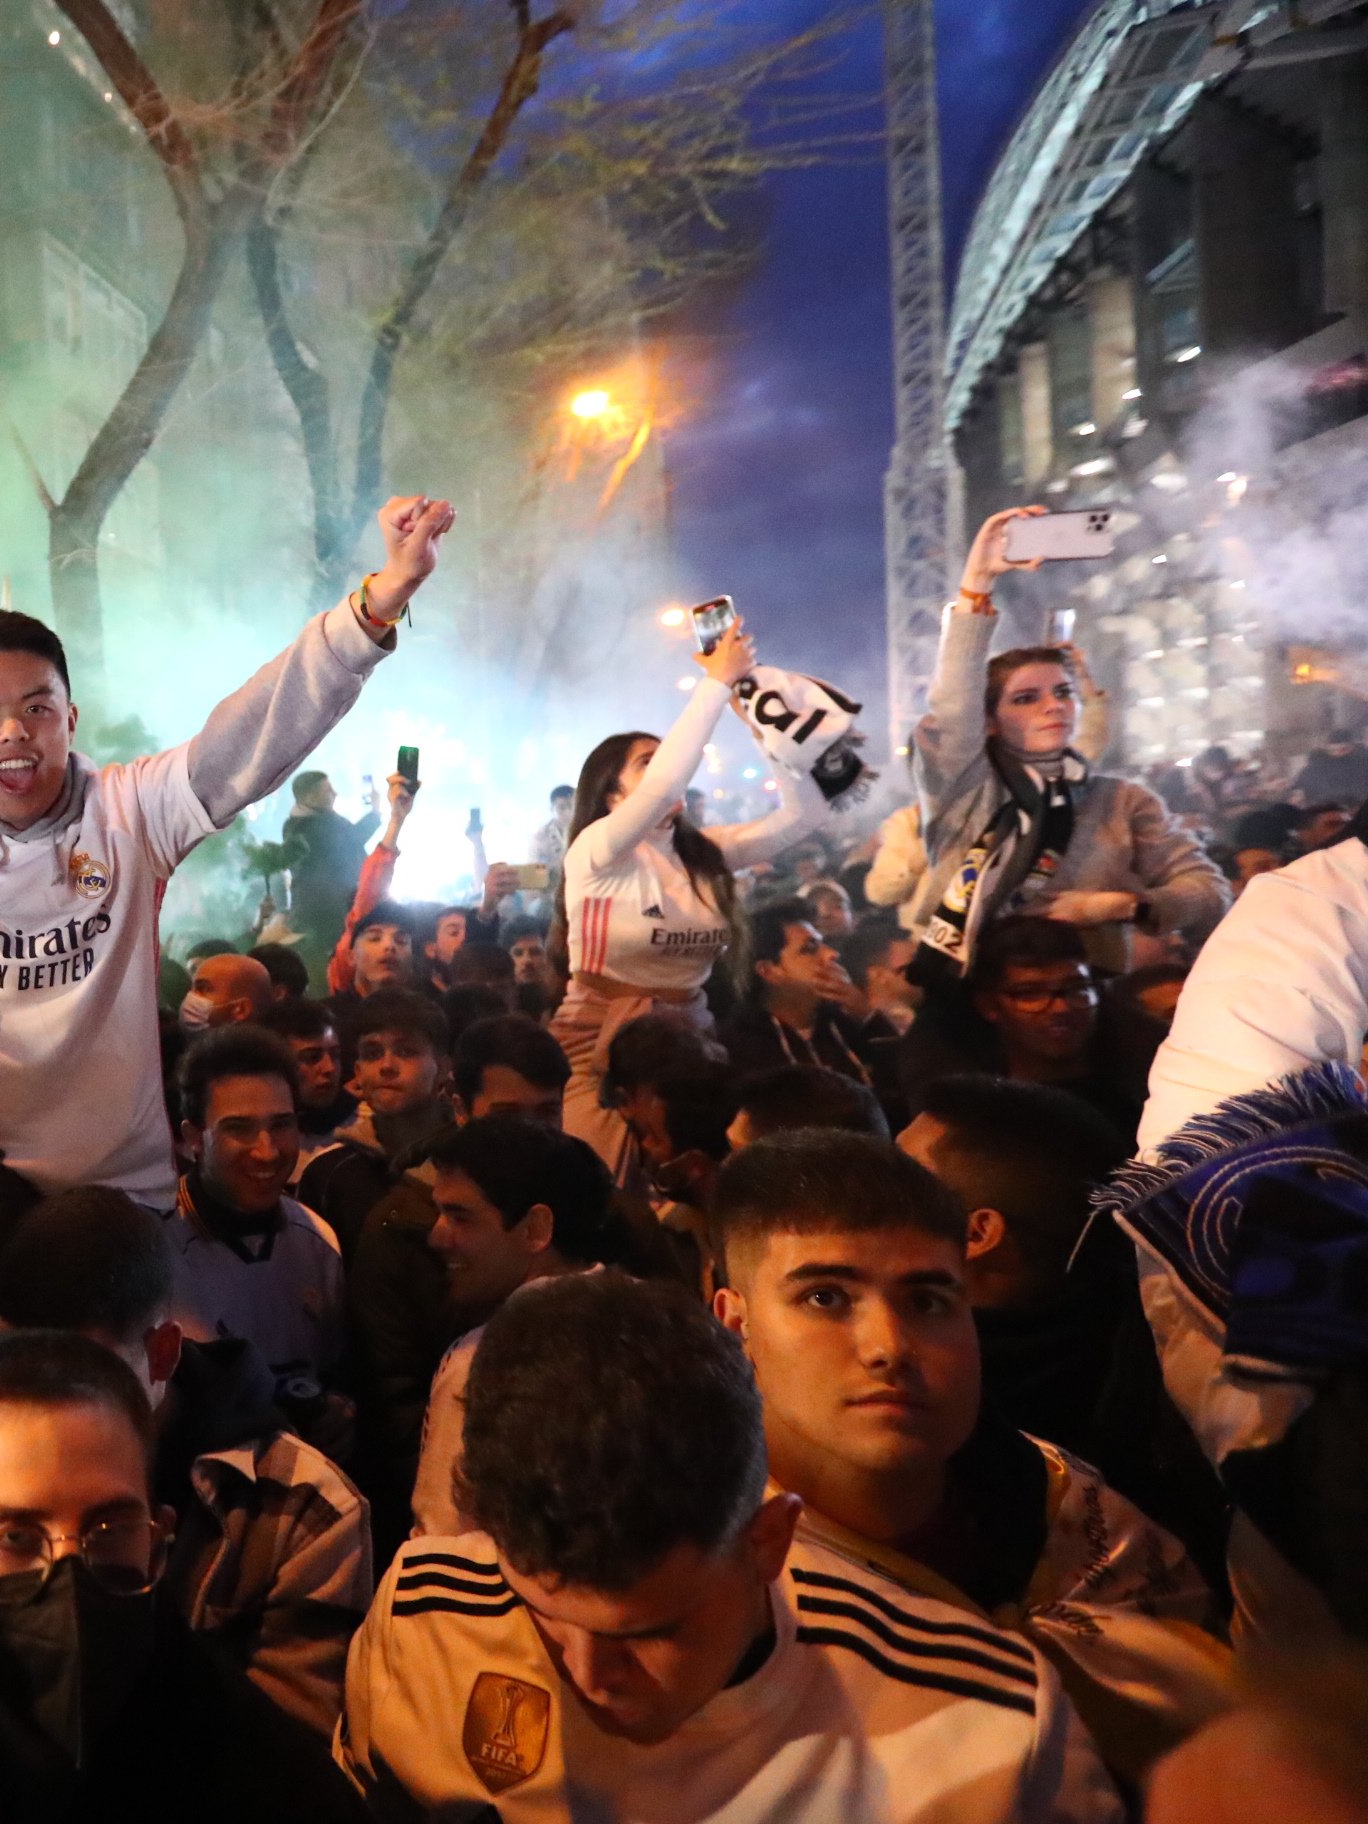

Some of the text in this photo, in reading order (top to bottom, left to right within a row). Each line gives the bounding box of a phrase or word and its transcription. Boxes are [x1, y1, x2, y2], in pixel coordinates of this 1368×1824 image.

[651, 927, 728, 945] Emirate
[18, 947, 95, 991] BETTER
[480, 1742, 518, 1767] FIFA
